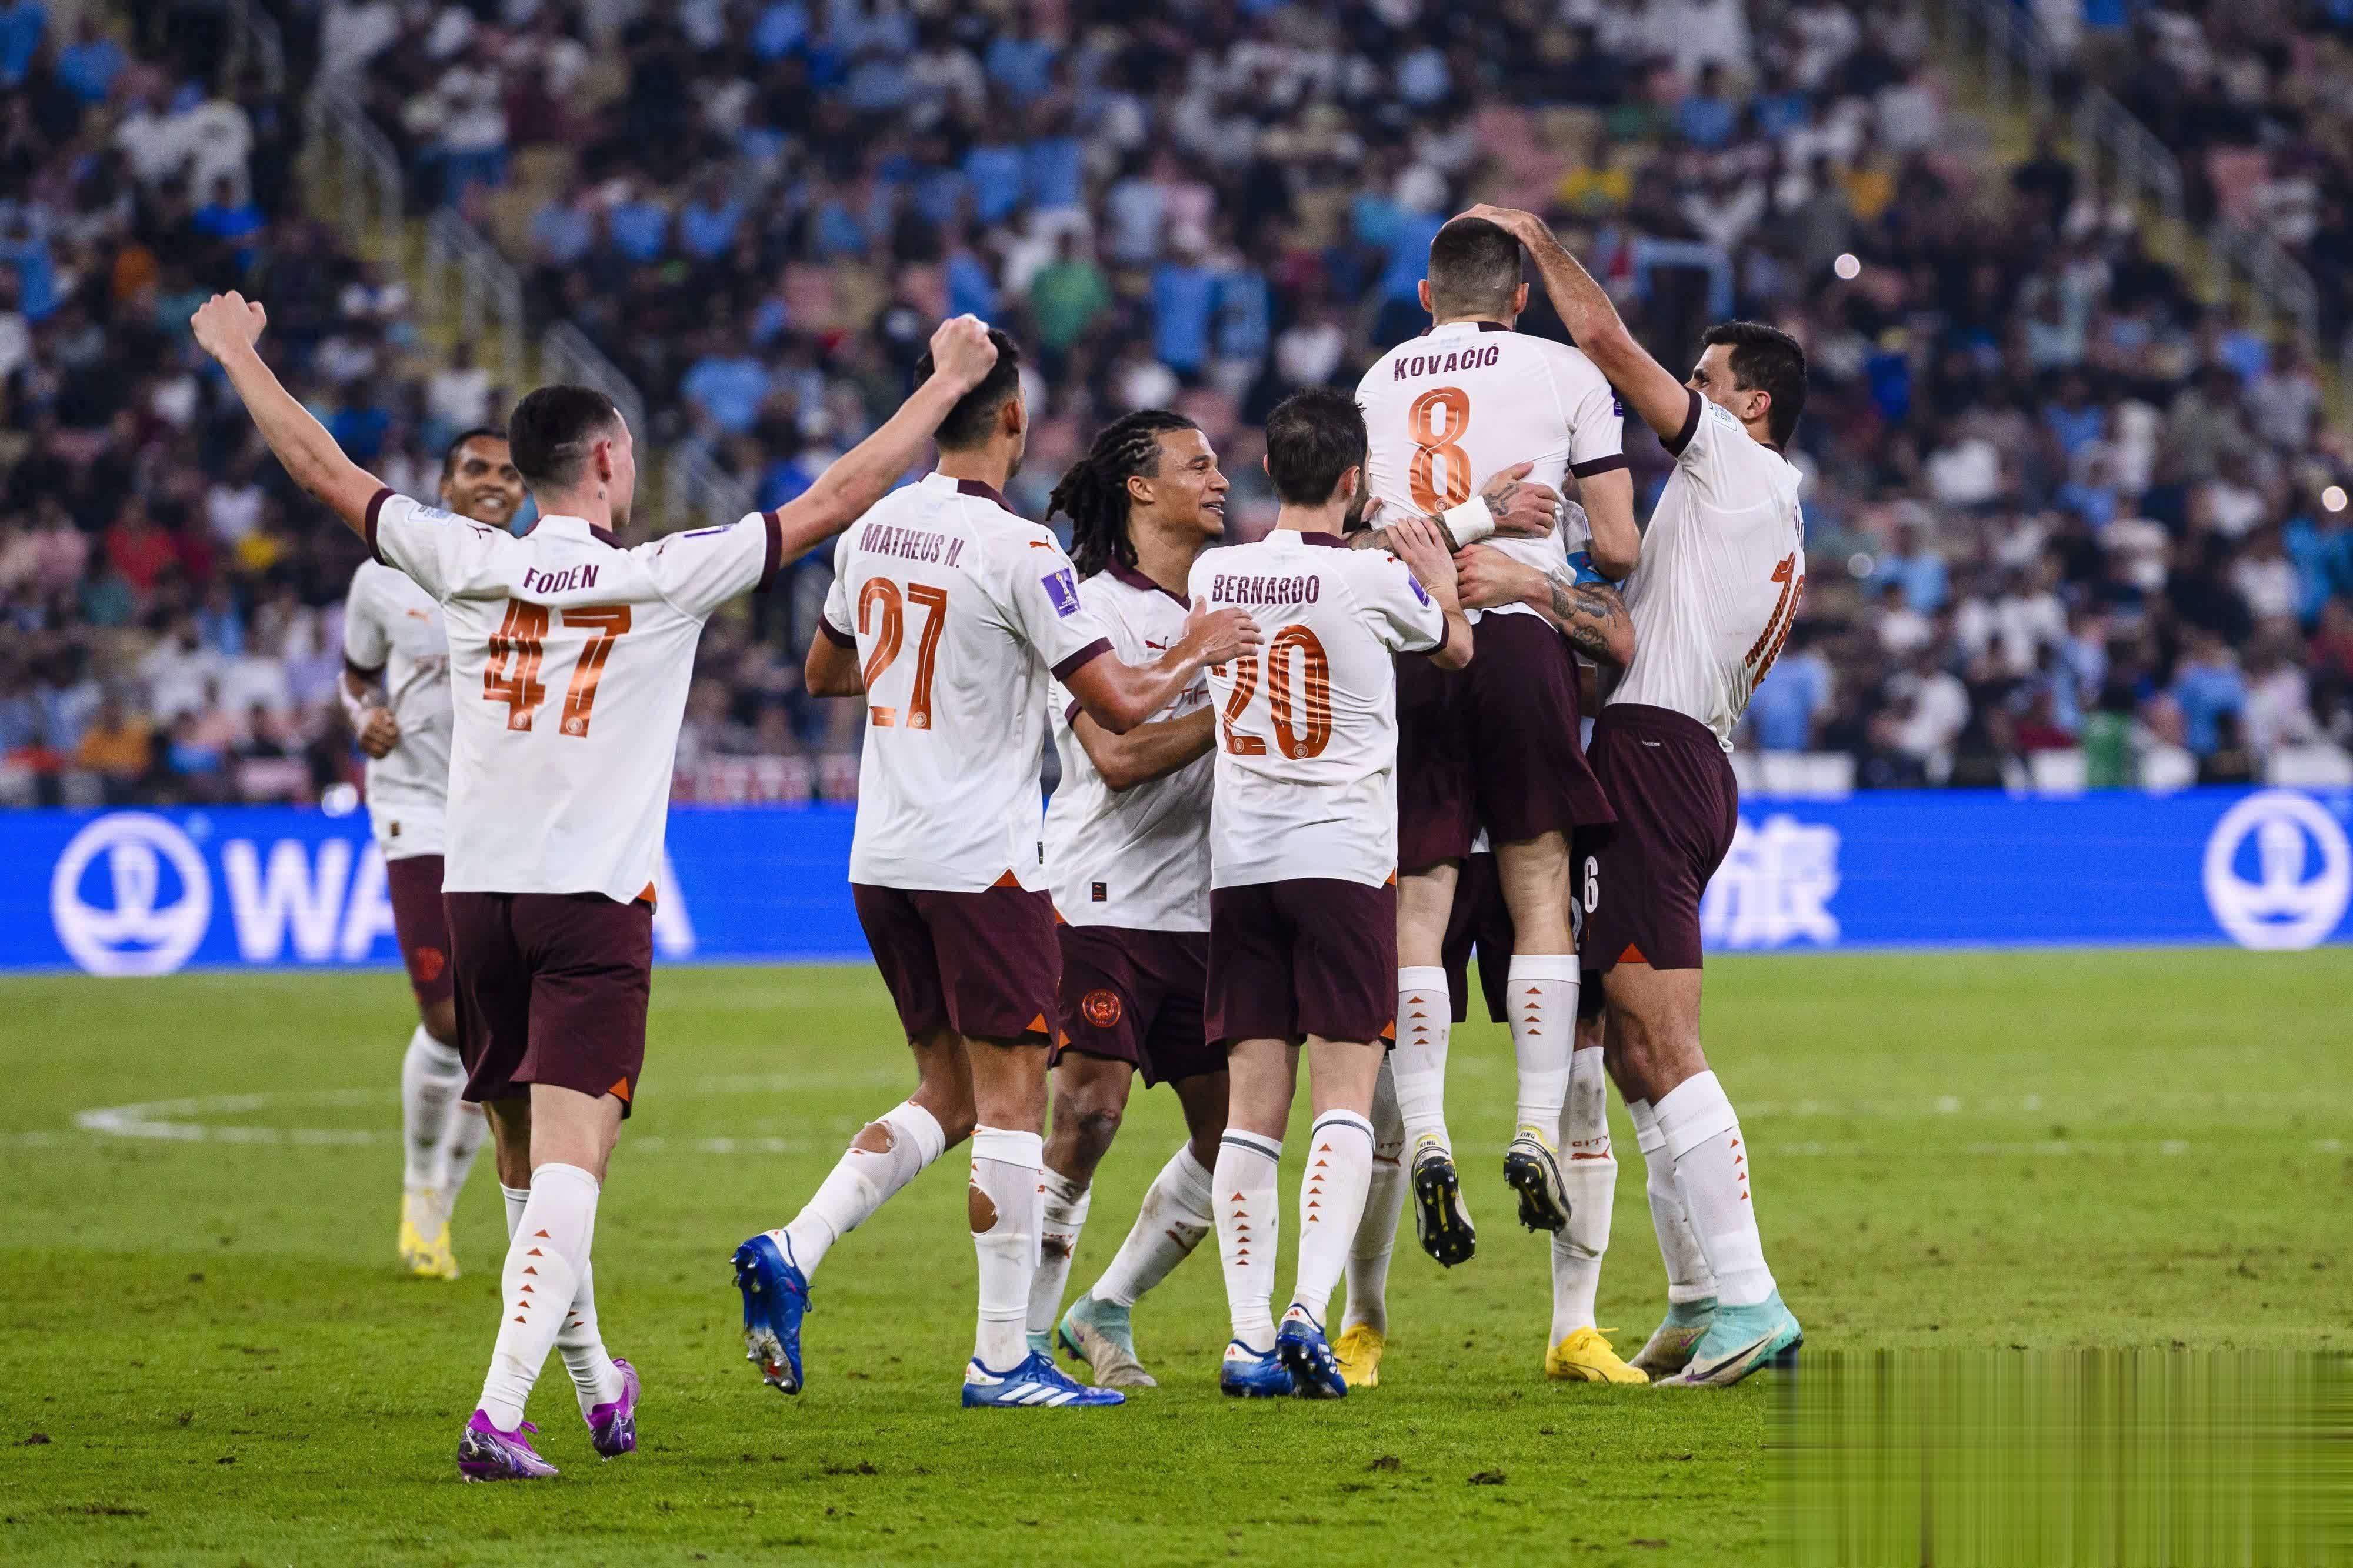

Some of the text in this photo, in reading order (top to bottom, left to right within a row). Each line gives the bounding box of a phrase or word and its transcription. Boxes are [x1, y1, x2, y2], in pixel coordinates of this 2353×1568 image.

[1393, 343, 1500, 382] KOVAČIĆ
[1408, 386, 1472, 516] 8
[859, 523, 965, 569] MATHEUS N.
[523, 565, 599, 594] FODEN
[1212, 574, 1320, 605] BERNARDO
[482, 598, 632, 738] 47
[858, 576, 948, 730] 27
[1211, 624, 1332, 760] 20
[1419, 1140, 1436, 1149] KING
